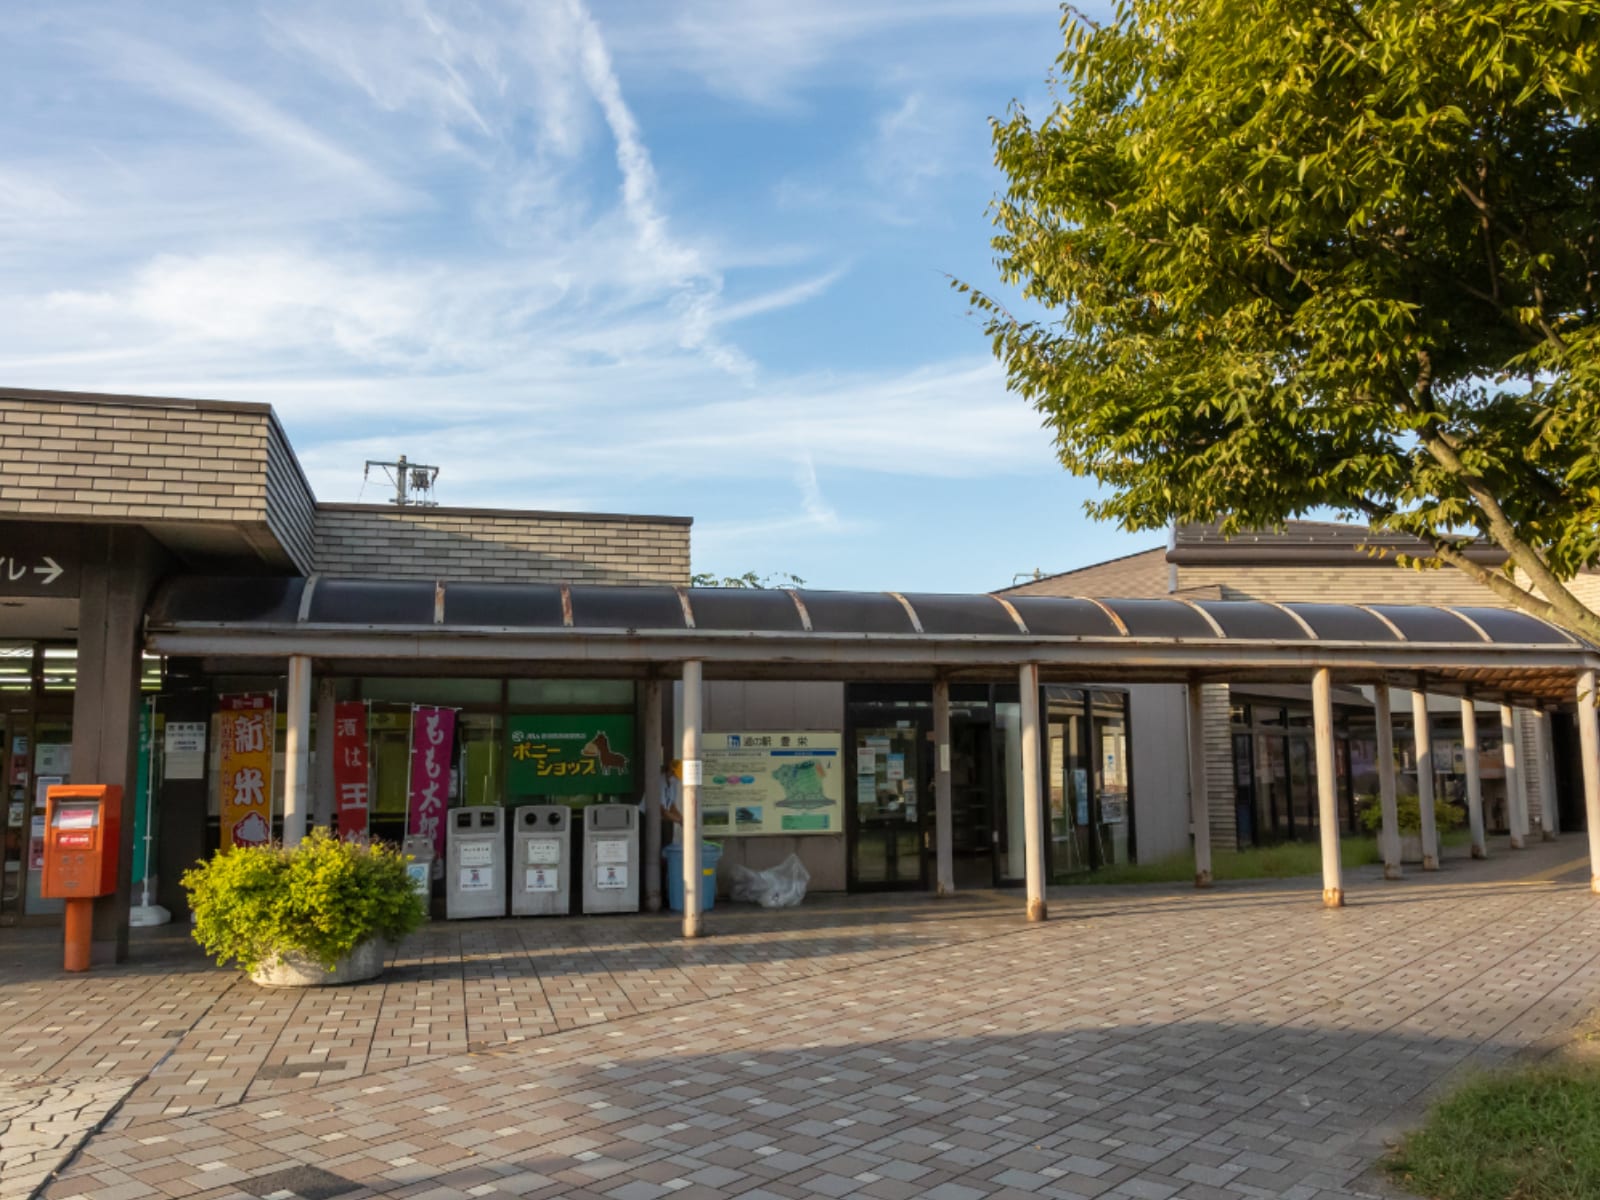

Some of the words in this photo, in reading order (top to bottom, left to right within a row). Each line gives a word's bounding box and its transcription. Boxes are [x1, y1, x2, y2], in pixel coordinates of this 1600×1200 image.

[234, 713, 265, 806] 新米
[418, 713, 444, 841] もも太郎
[512, 742, 561, 761] ポニー
[536, 758, 597, 776] ショップ
